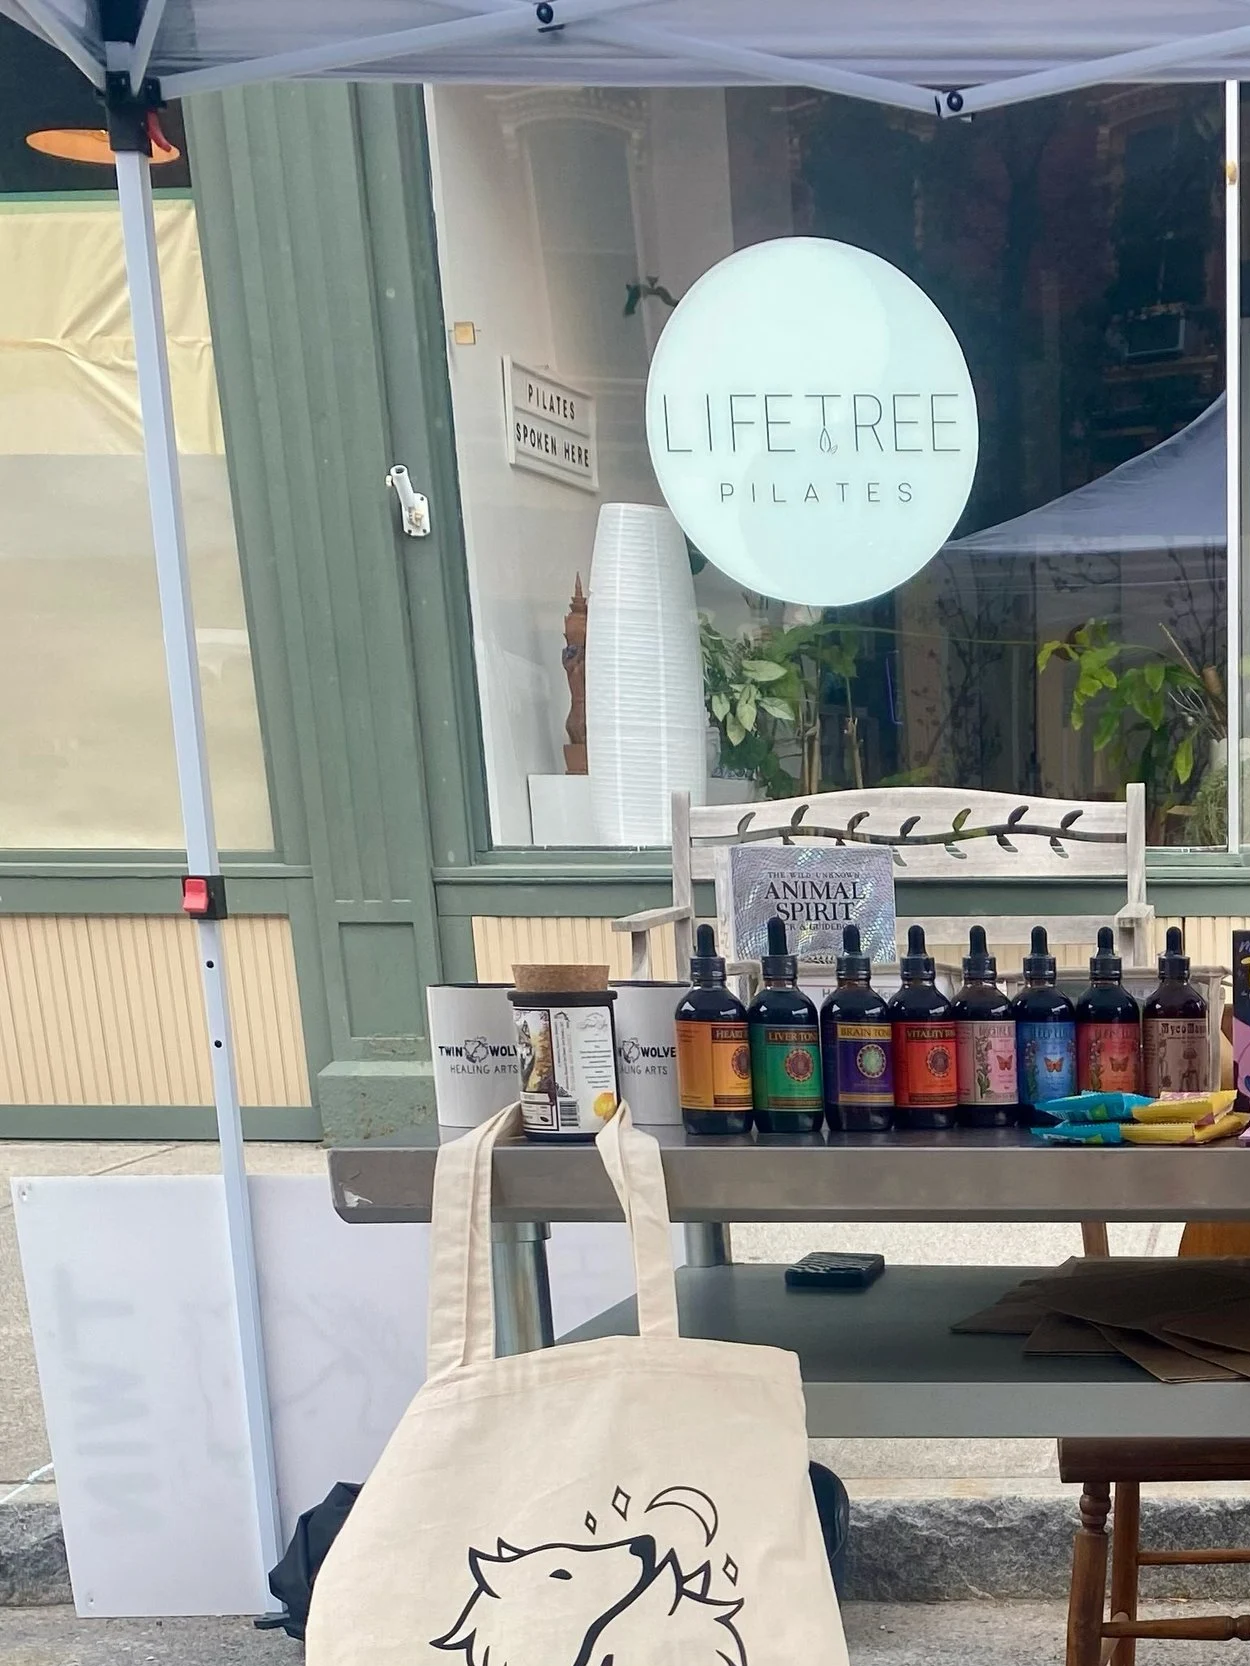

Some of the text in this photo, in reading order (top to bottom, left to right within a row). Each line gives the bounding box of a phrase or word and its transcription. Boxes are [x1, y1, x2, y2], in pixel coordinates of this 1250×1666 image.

[527, 383, 575, 420] PILATES
[515, 422, 589, 468] SPOKEN HERE
[719, 481, 913, 503] PILATES
[767, 871, 860, 879] THE WILD UNKNOWN
[764, 881, 865, 900] ANIMAL
[776, 901, 855, 922] SPIRIT
[808, 922, 862, 932] GUIDEBOK
[768, 1031, 816, 1041] LIVER TON
[839, 1027, 889, 1038] BRAIN TON
[906, 1029, 943, 1038] VITALITY
[438, 1045, 518, 1058] TWIN WOL
[640, 1046, 677, 1059] WOLVE
[450, 1064, 519, 1075] HEALING ARTS
[645, 1065, 669, 1075] ARTS
